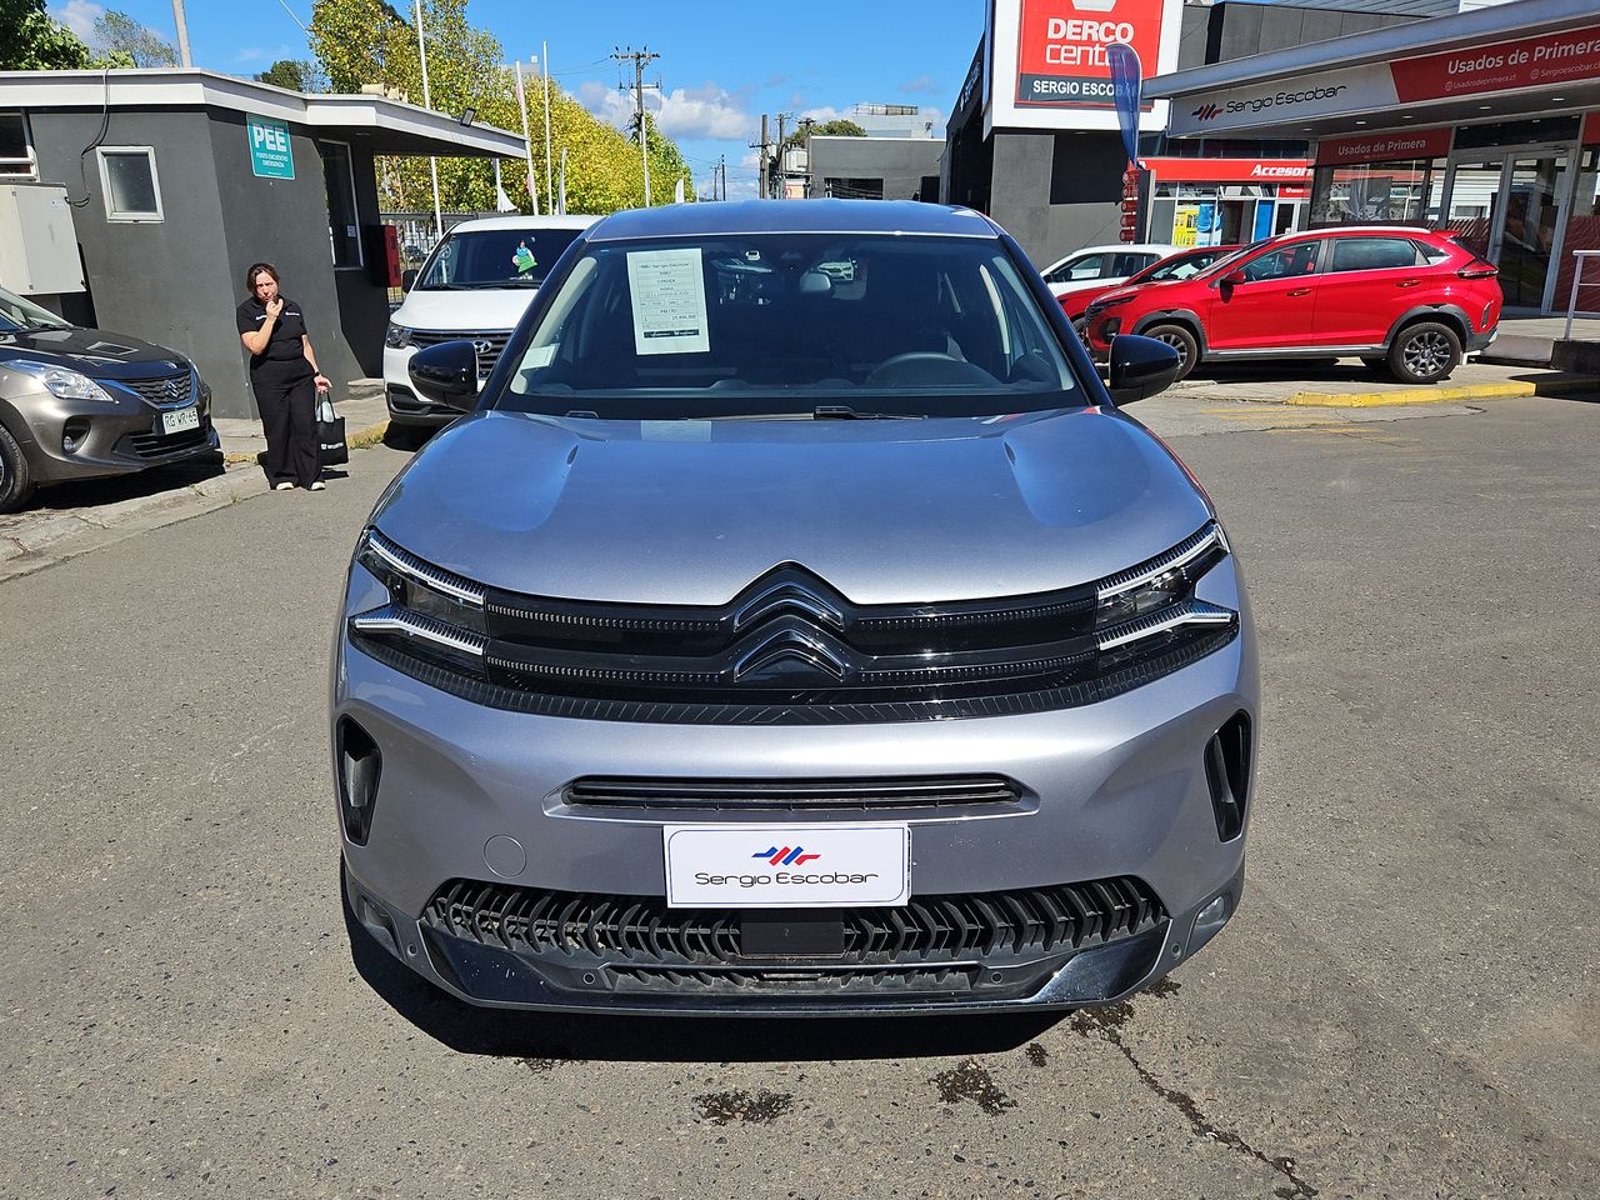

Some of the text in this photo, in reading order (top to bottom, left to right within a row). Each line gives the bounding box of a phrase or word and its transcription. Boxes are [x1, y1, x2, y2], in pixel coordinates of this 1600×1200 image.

[1047, 18, 1135, 44] DERCO
[1045, 43, 1111, 66] cent
[1447, 38, 1600, 75] Usados de Primera
[1033, 80, 1080, 95] SERGIO
[1225, 85, 1347, 113] Sergio Escobar
[252, 123, 288, 153] PEE
[1338, 144, 1371, 156] Usados
[1373, 142, 1385, 152] de
[1387, 139, 1426, 151] Primera
[1250, 163, 1314, 177] Accesori
[694, 871, 879, 888] Sergio Escobar
